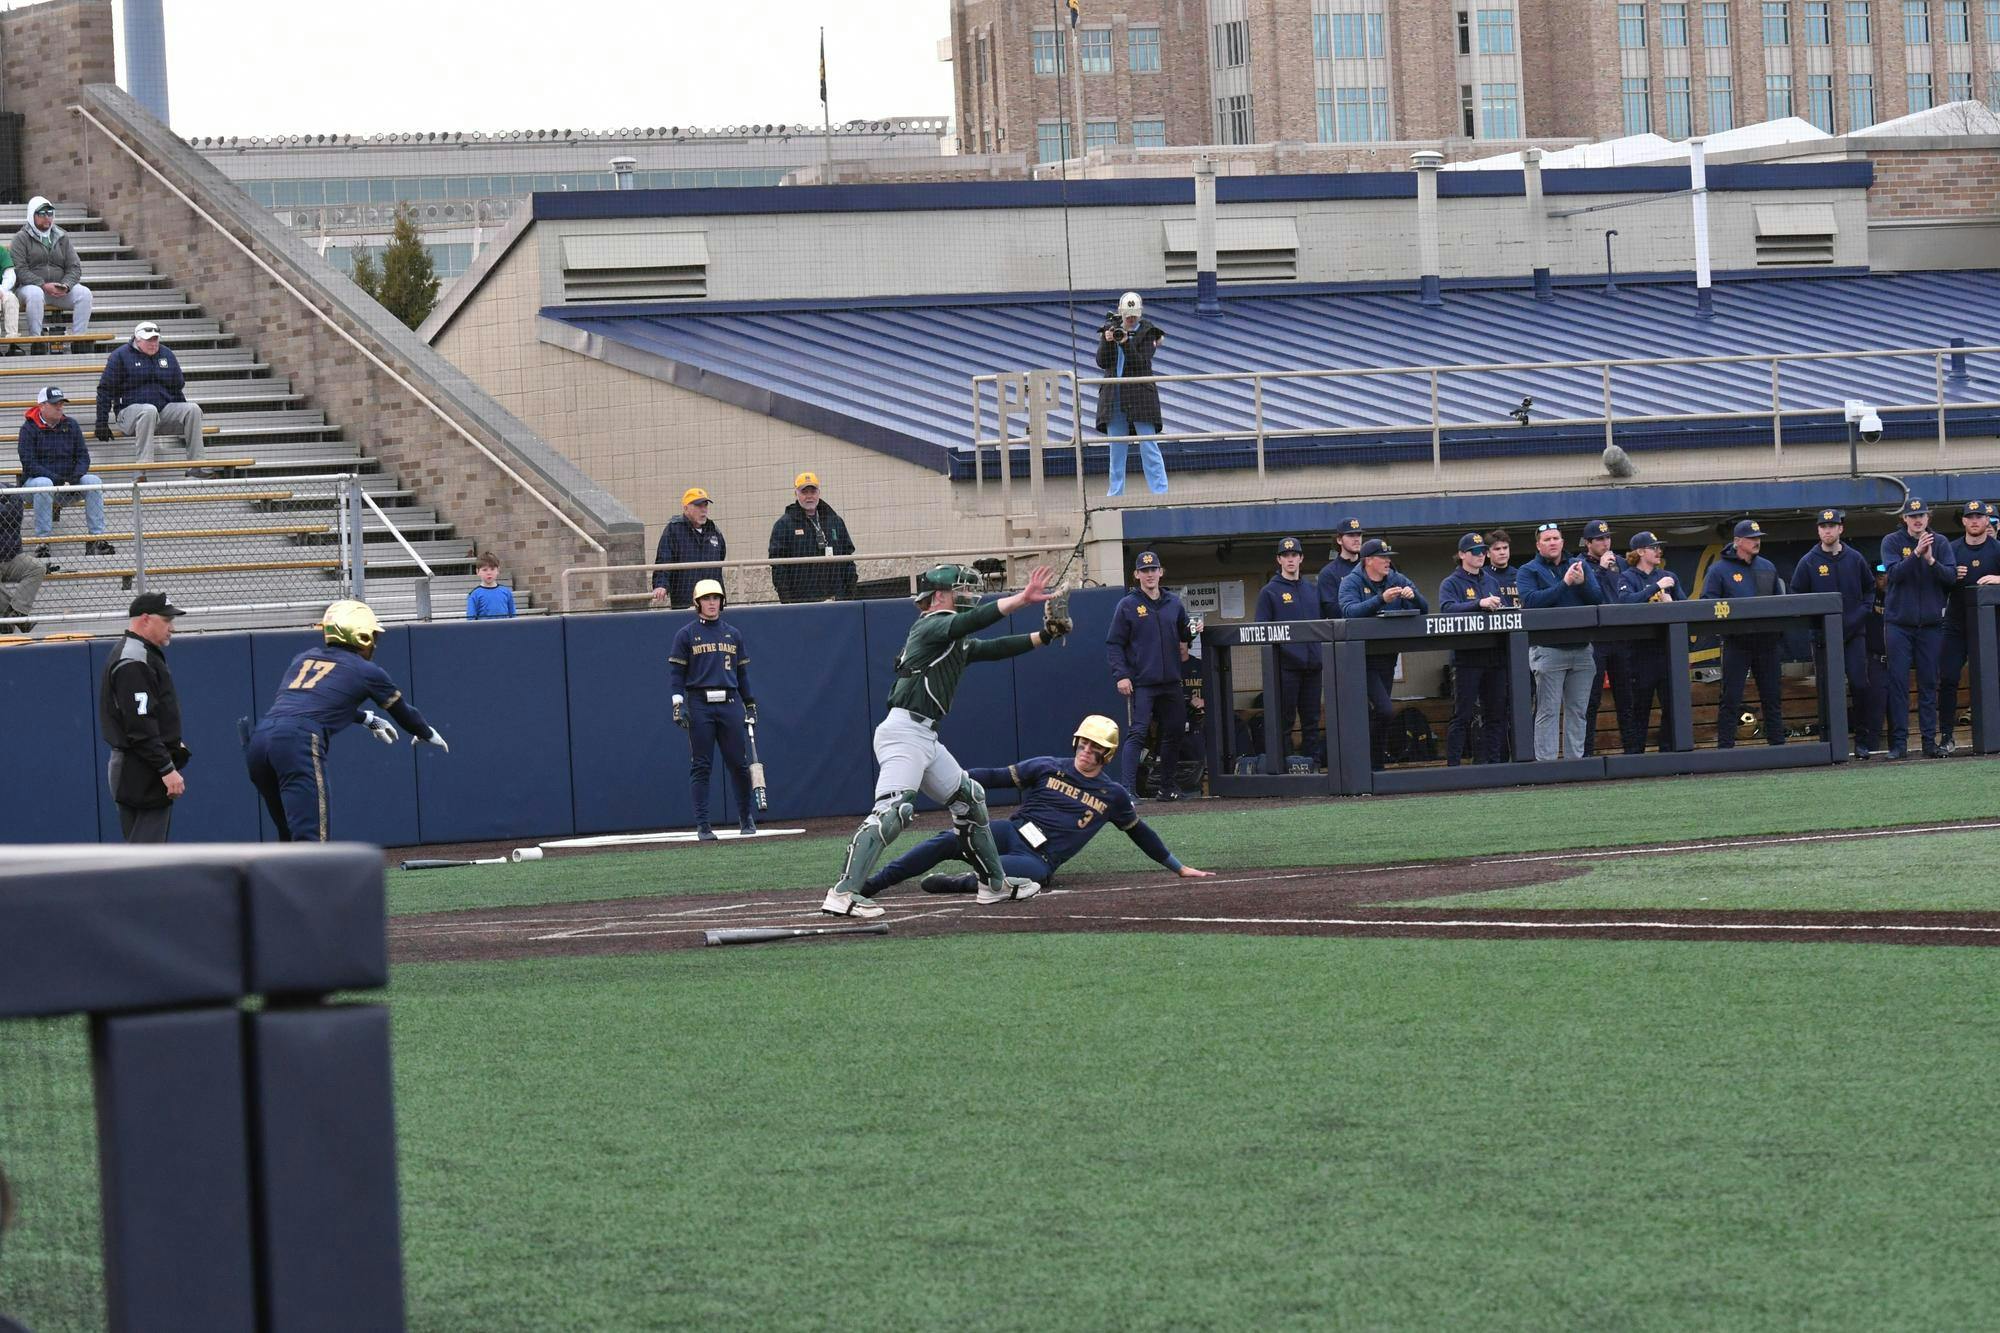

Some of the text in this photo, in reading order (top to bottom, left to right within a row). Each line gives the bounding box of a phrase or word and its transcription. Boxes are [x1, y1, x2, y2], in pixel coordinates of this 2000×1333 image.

[1426, 613, 1523, 634] FIGHTING IRISH
[1240, 625, 1291, 643] NOTRE DAME
[692, 643, 737, 655] NOTRE DAME
[724, 655, 731, 670] 2
[288, 659, 337, 689] 17
[1185, 679, 1203, 687] DAME
[134, 692, 149, 715] 7
[1046, 777, 1108, 815] NOTRE DAME
[1077, 810, 1094, 829] 3
